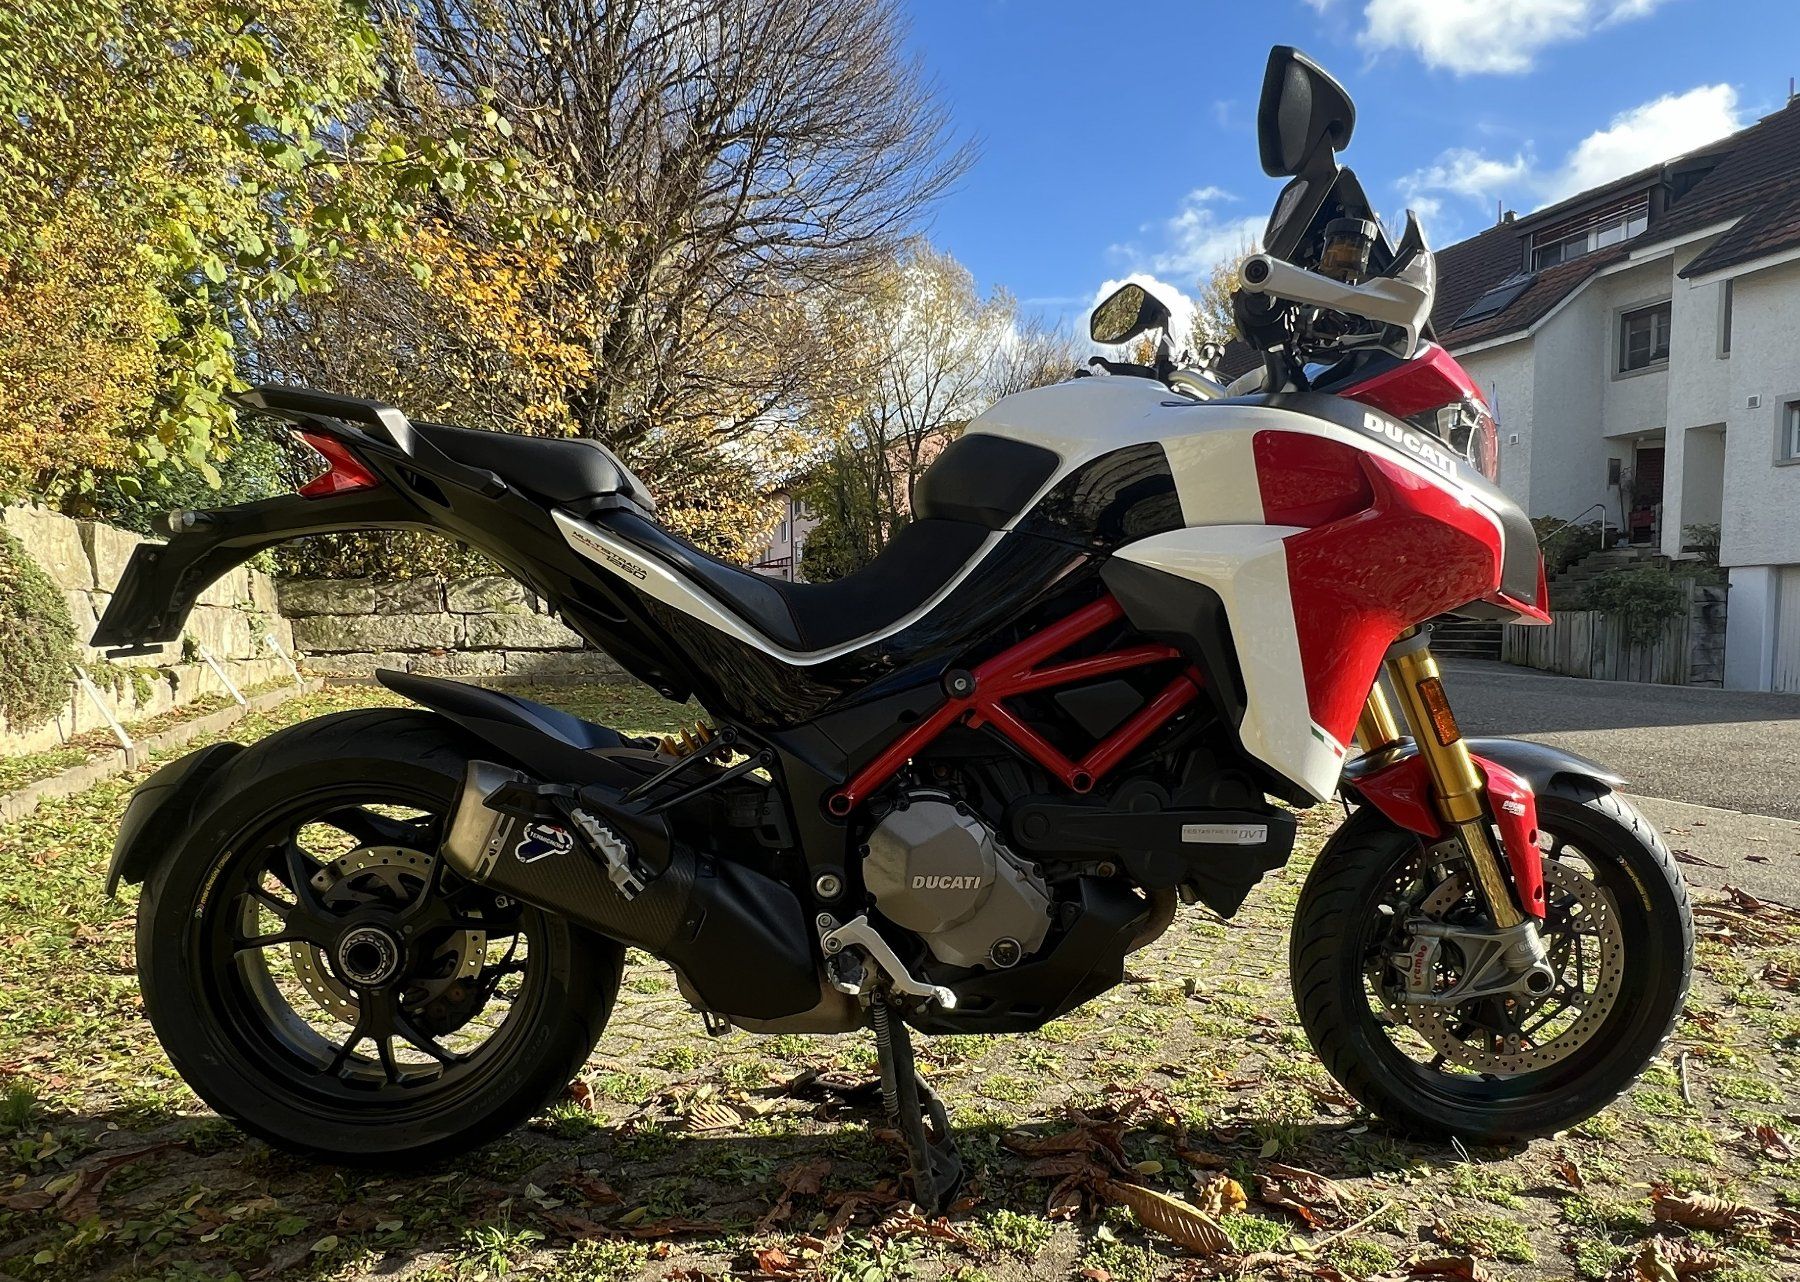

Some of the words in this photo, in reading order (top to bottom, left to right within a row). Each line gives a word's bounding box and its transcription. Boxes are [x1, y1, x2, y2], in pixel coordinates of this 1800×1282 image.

[1363, 412, 1458, 478] DUCATI
[1239, 829, 1266, 839] DVT
[912, 875, 981, 889] DUCATI
[1412, 944, 1428, 987] brembo
